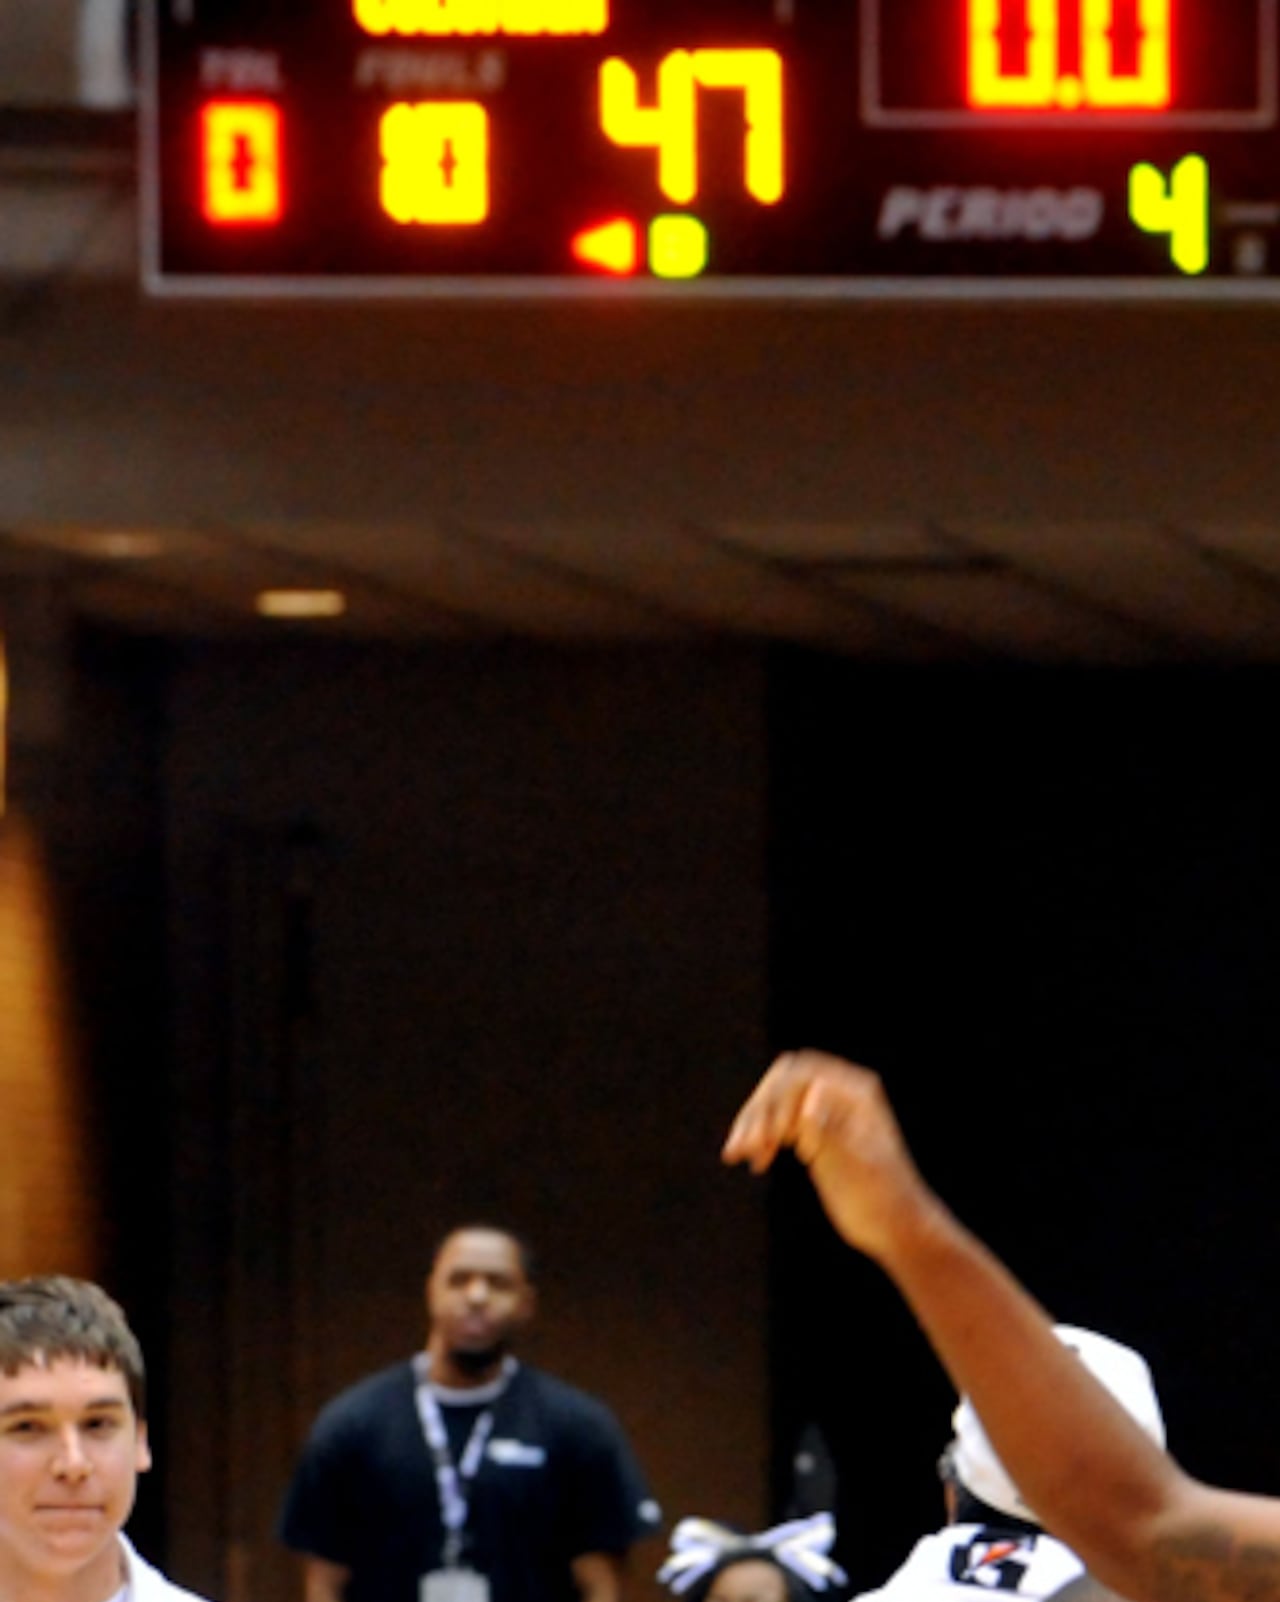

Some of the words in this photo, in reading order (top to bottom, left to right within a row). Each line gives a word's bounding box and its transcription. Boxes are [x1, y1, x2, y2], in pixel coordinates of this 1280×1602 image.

[969, 0, 1169, 108] 0.0
[203, 102, 281, 222] 0
[600, 48, 782, 204] 47
[878, 185, 1103, 241] PERIOD
[1129, 154, 1208, 274] 4
